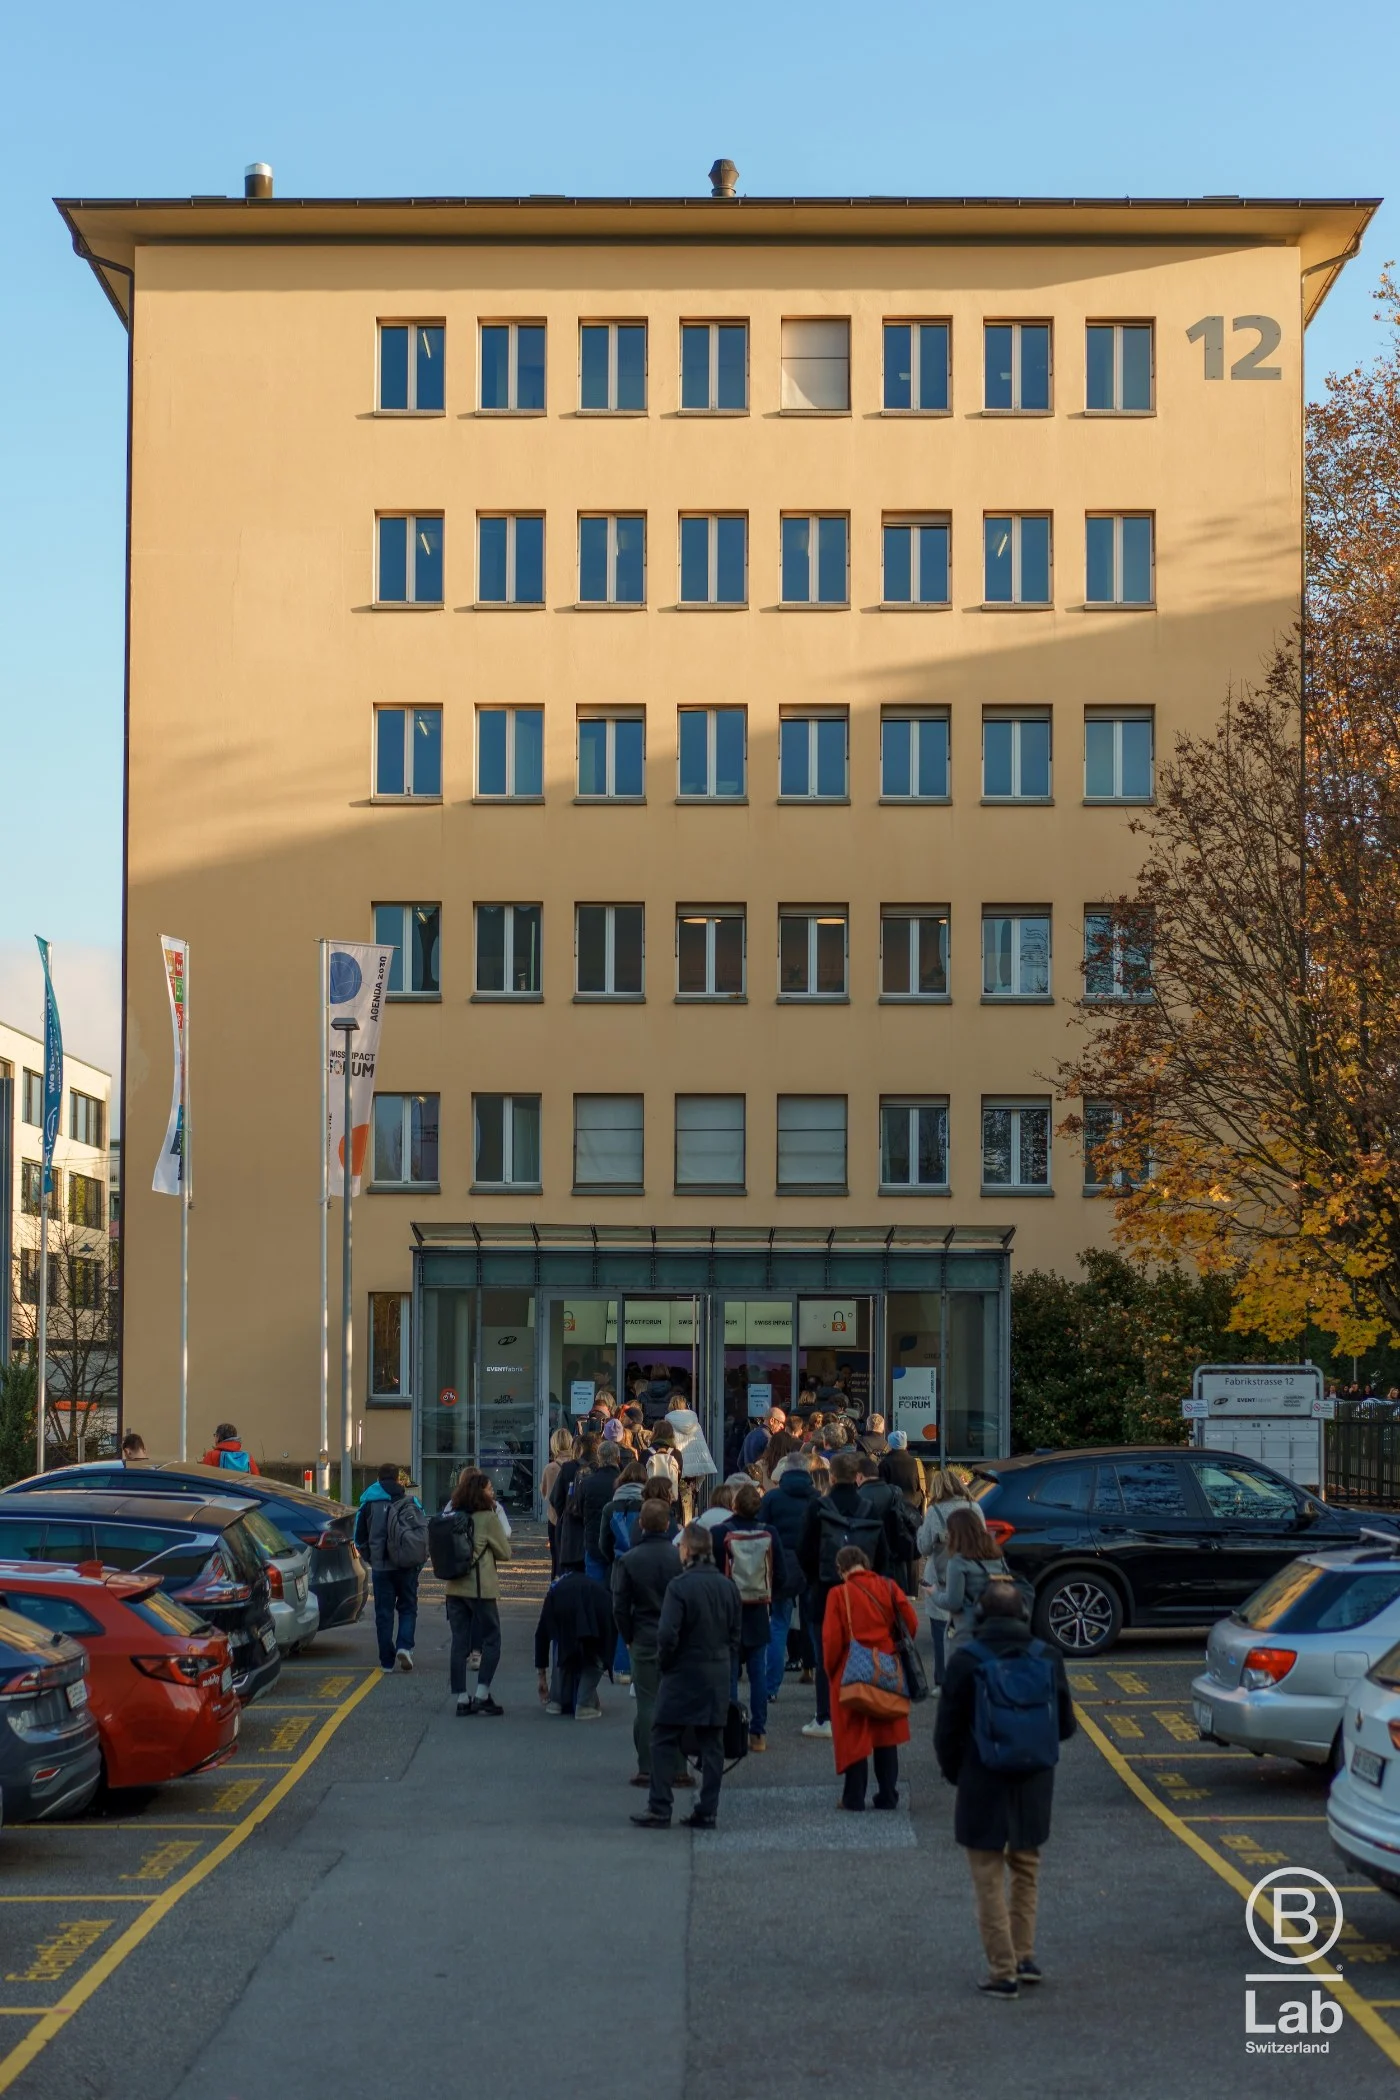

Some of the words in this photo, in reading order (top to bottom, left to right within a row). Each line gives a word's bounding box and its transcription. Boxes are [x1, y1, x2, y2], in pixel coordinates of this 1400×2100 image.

[1185, 314, 1282, 381] 12
[370, 982, 383, 1022] AGENDA
[377, 956, 387, 980] 2030
[330, 1050, 346, 1059] WISS
[330, 1059, 375, 1078] FOUM
[1225, 1377, 1283, 1386] Fabrikstrasse
[1284, 1377, 1295, 1386] 12
[898, 1400, 931, 1409] FORUM
